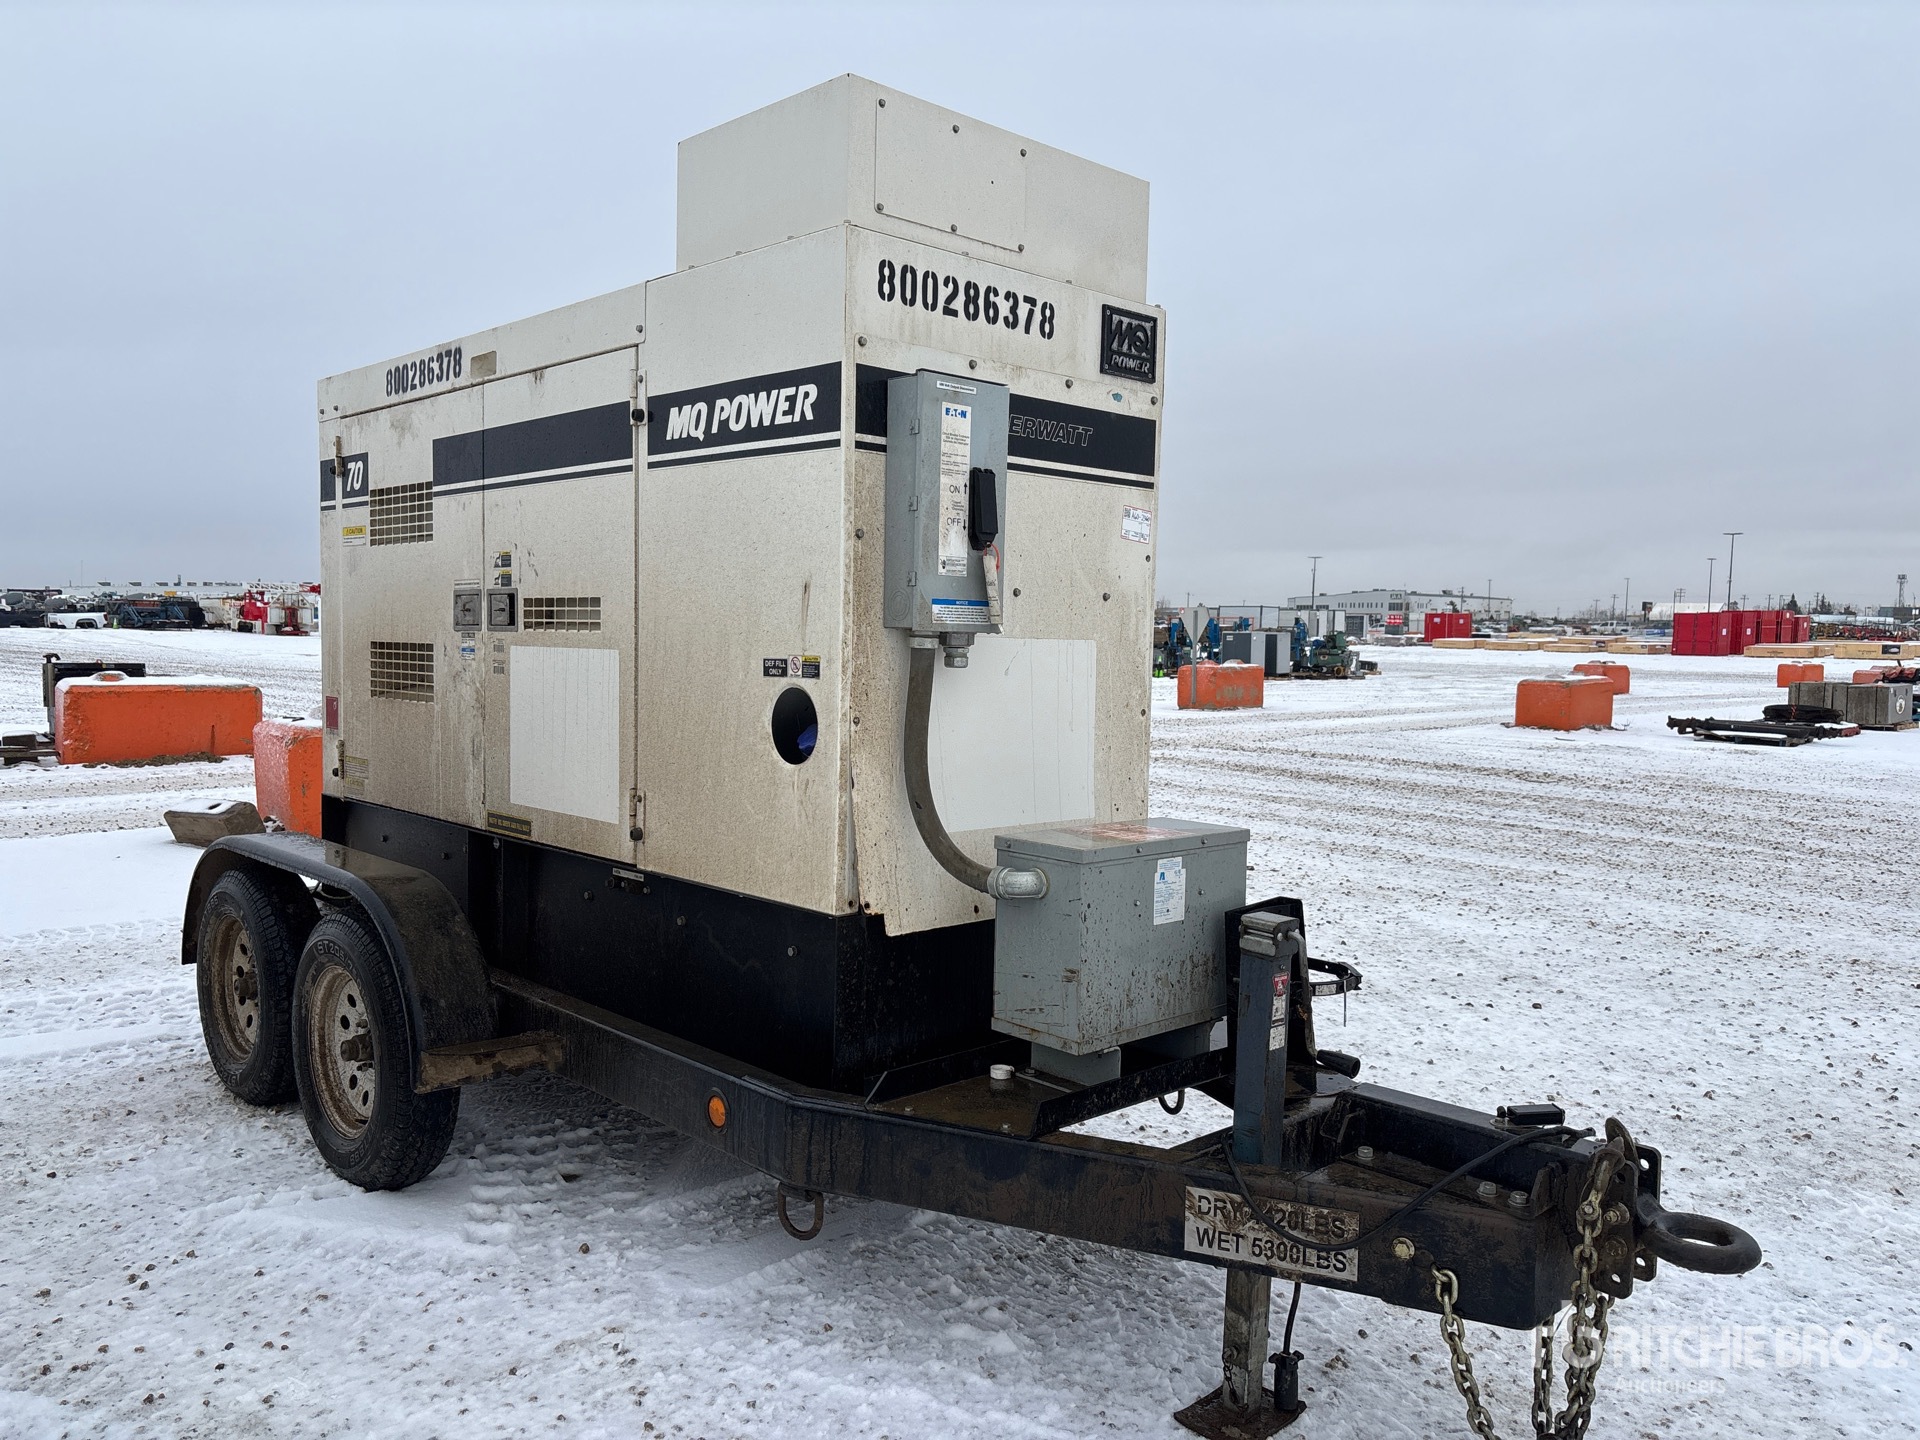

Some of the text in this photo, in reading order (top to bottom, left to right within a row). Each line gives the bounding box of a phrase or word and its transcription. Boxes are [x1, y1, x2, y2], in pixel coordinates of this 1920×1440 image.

[877, 258, 1056, 340] 800286378
[1105, 314, 1151, 356] MQ
[385, 345, 463, 397] 800286378
[1110, 354, 1150, 373] POWER
[666, 383, 818, 442] MQ POWER
[346, 460, 364, 491] 70
[948, 484, 961, 494] ON
[946, 517, 962, 526] OFF
[1196, 1226, 1244, 1254] WET
